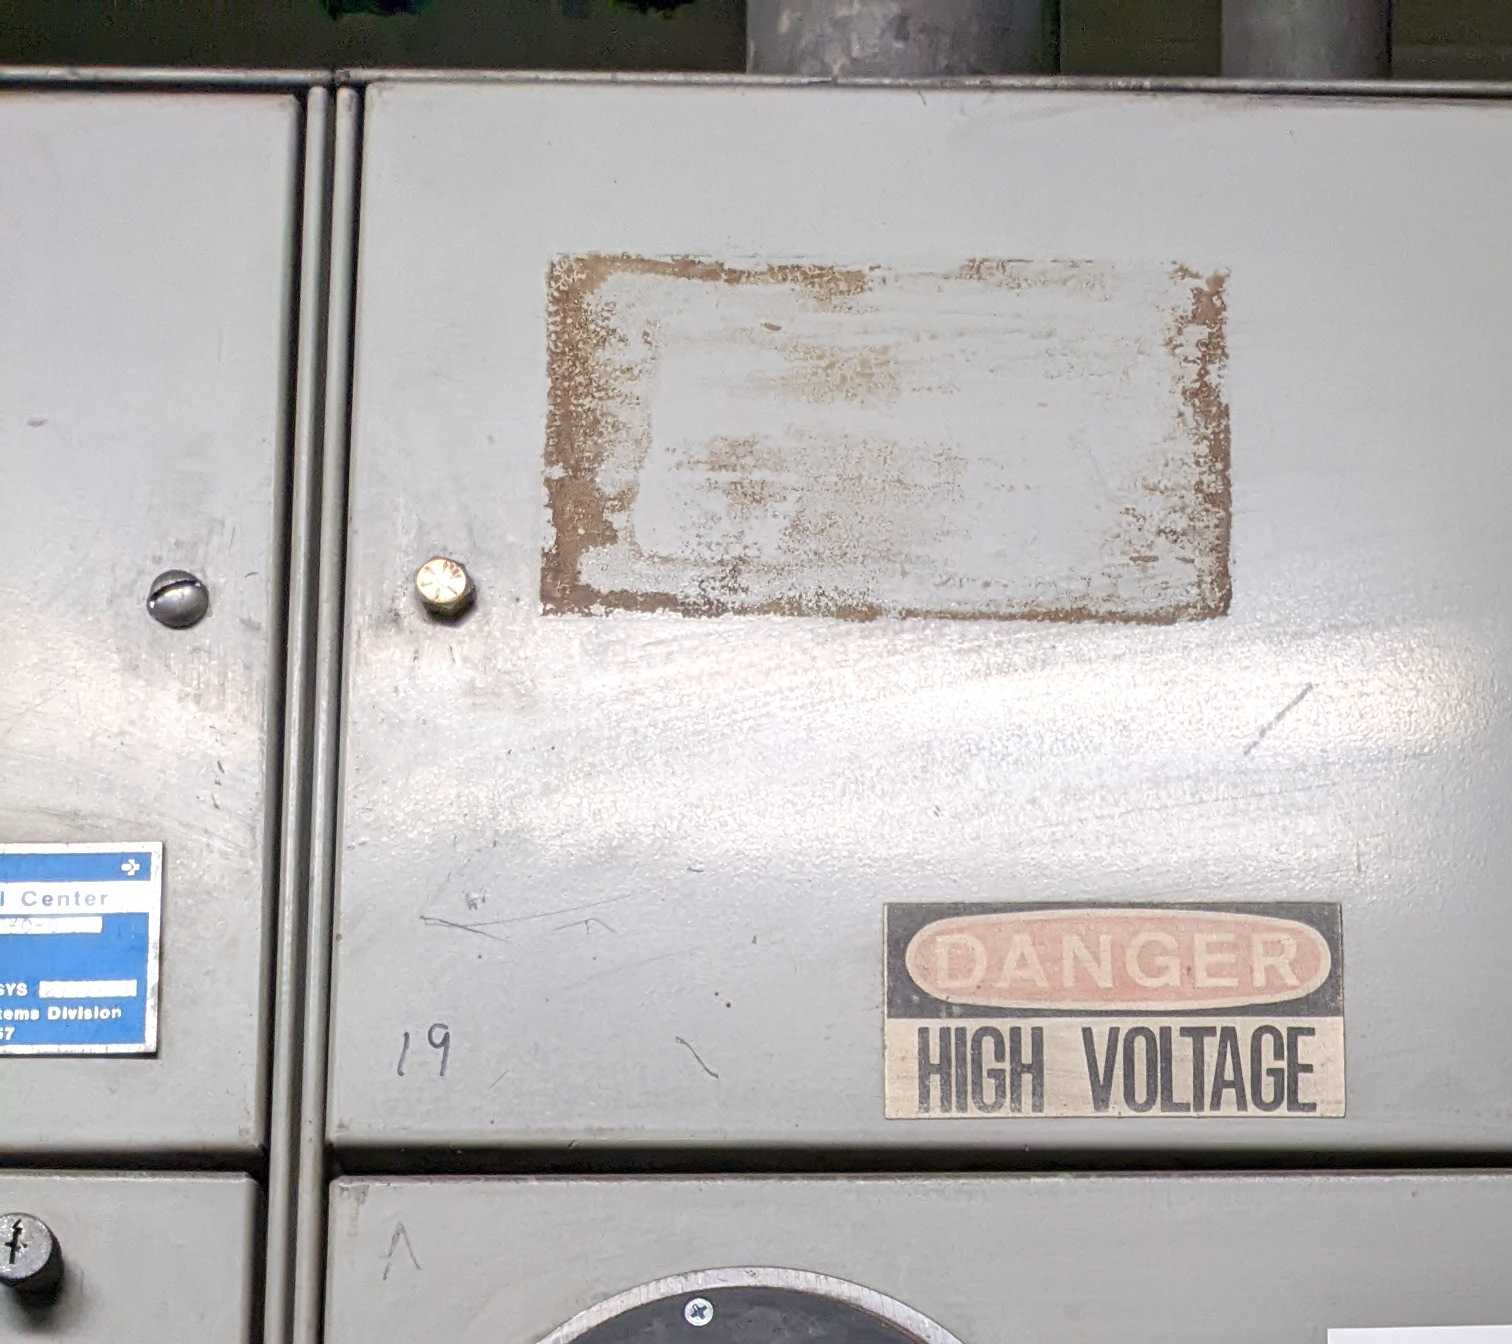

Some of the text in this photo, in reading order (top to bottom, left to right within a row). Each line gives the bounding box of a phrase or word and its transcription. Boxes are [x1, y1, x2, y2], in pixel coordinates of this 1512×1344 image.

[21, 890, 109, 907] Center
[934, 931, 1302, 990] DANGER
[47, 1006, 122, 1020] Division
[397, 1022, 450, 1077] 19
[917, 1025, 1317, 1113] HIGH VOLTAGE
